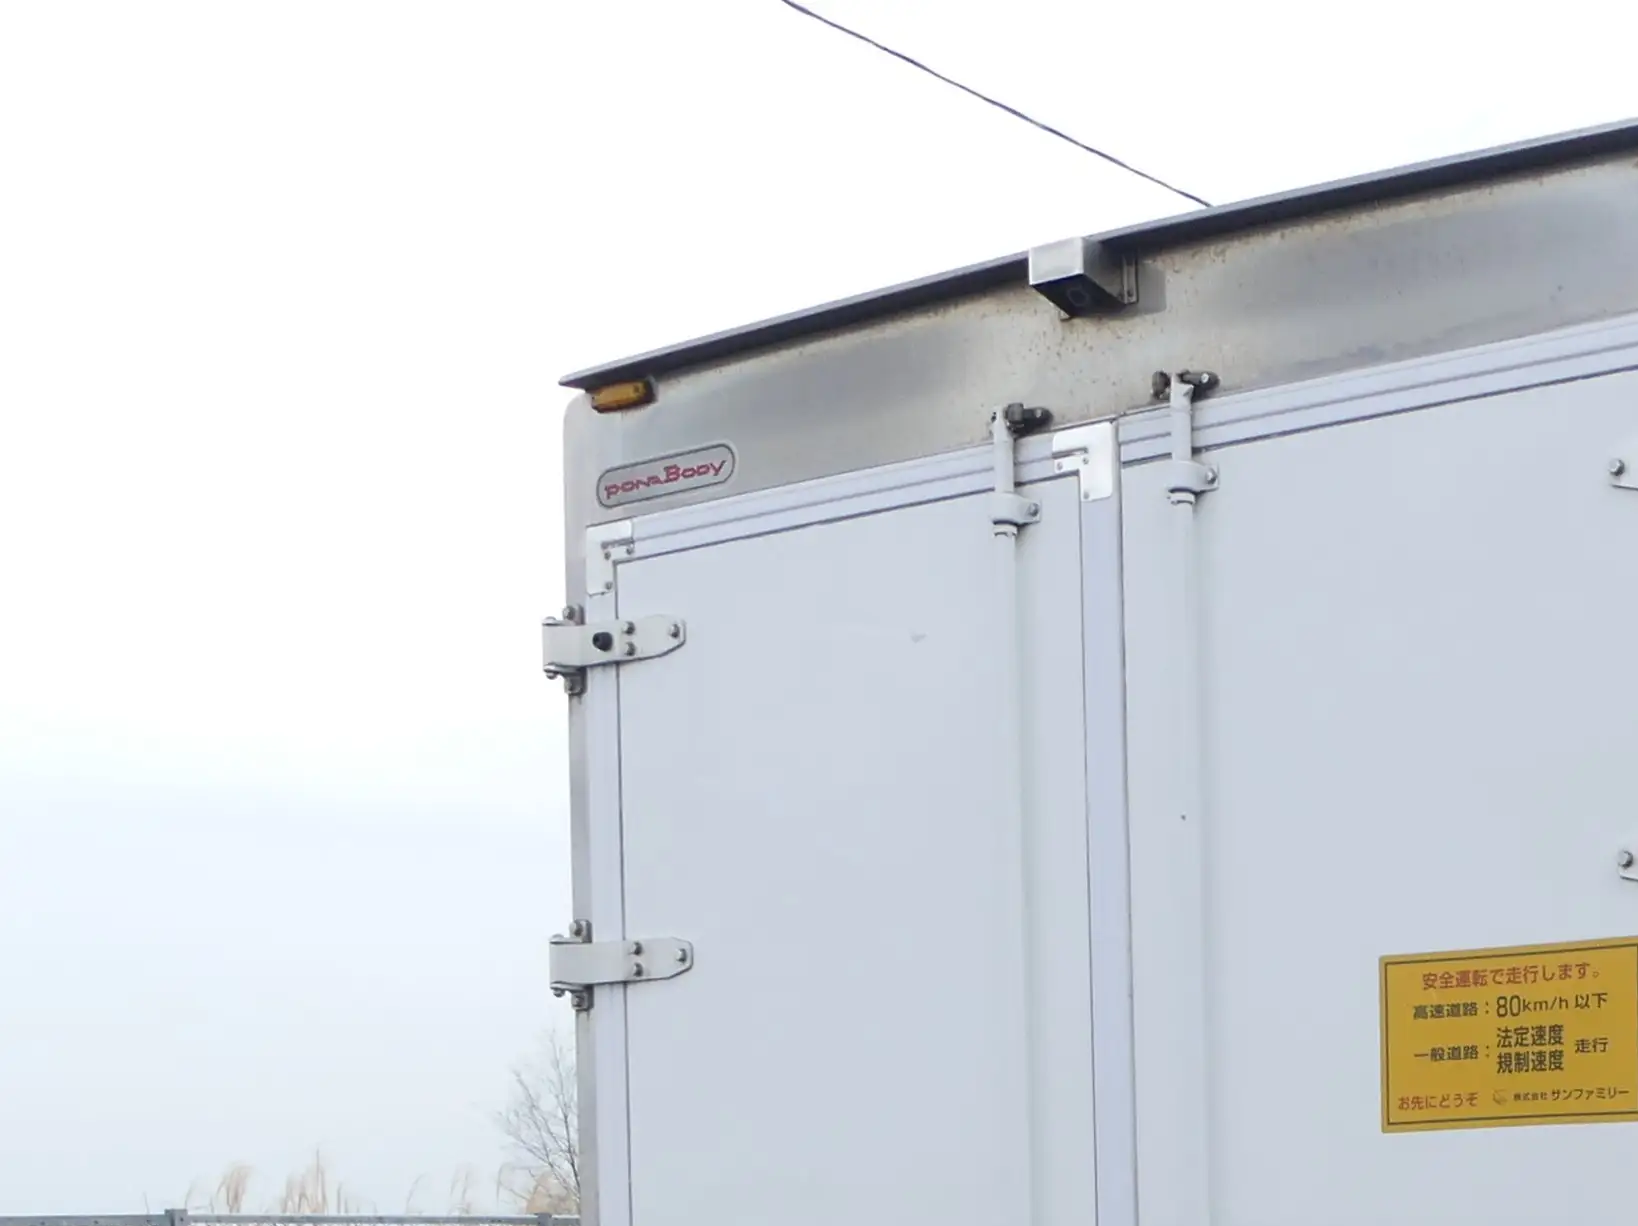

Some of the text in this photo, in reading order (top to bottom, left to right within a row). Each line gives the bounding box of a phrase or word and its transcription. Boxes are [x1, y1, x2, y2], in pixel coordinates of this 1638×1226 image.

[1422, 963, 1600, 991] 安全運転で走行します。
[1496, 994, 1569, 1018] 80km/h
[1575, 992, 1608, 1009] 以下
[1496, 1024, 1564, 1048] 法定速度
[1575, 1038, 1609, 1054] 走行
[1496, 1050, 1564, 1074] 規制速度
[1398, 1091, 1479, 1111] お先にどうぞ
[1551, 1086, 1630, 1102] サンファミリー
